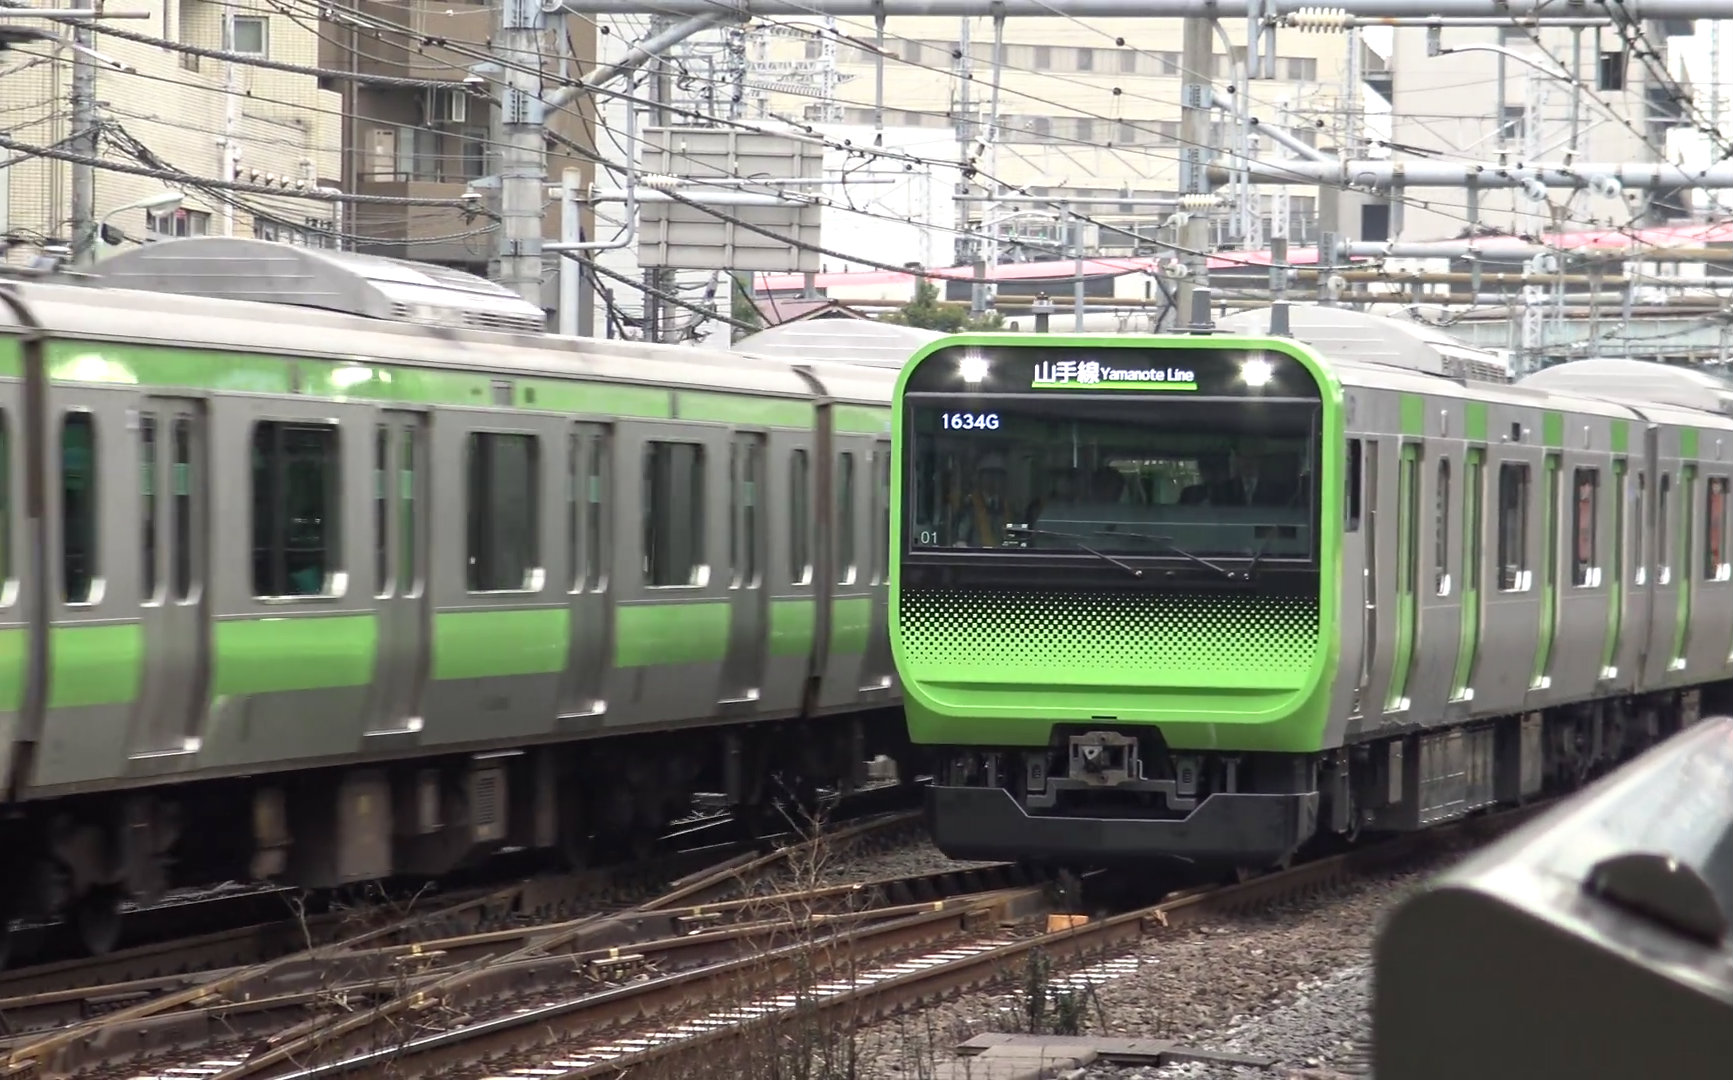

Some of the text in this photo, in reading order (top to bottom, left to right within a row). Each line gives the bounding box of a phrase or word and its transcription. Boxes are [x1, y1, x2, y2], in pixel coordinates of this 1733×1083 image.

[1035, 361, 1194, 384] 山手線 Yamanote Line
[942, 413, 999, 429] 1634G
[921, 531, 937, 544] 01
